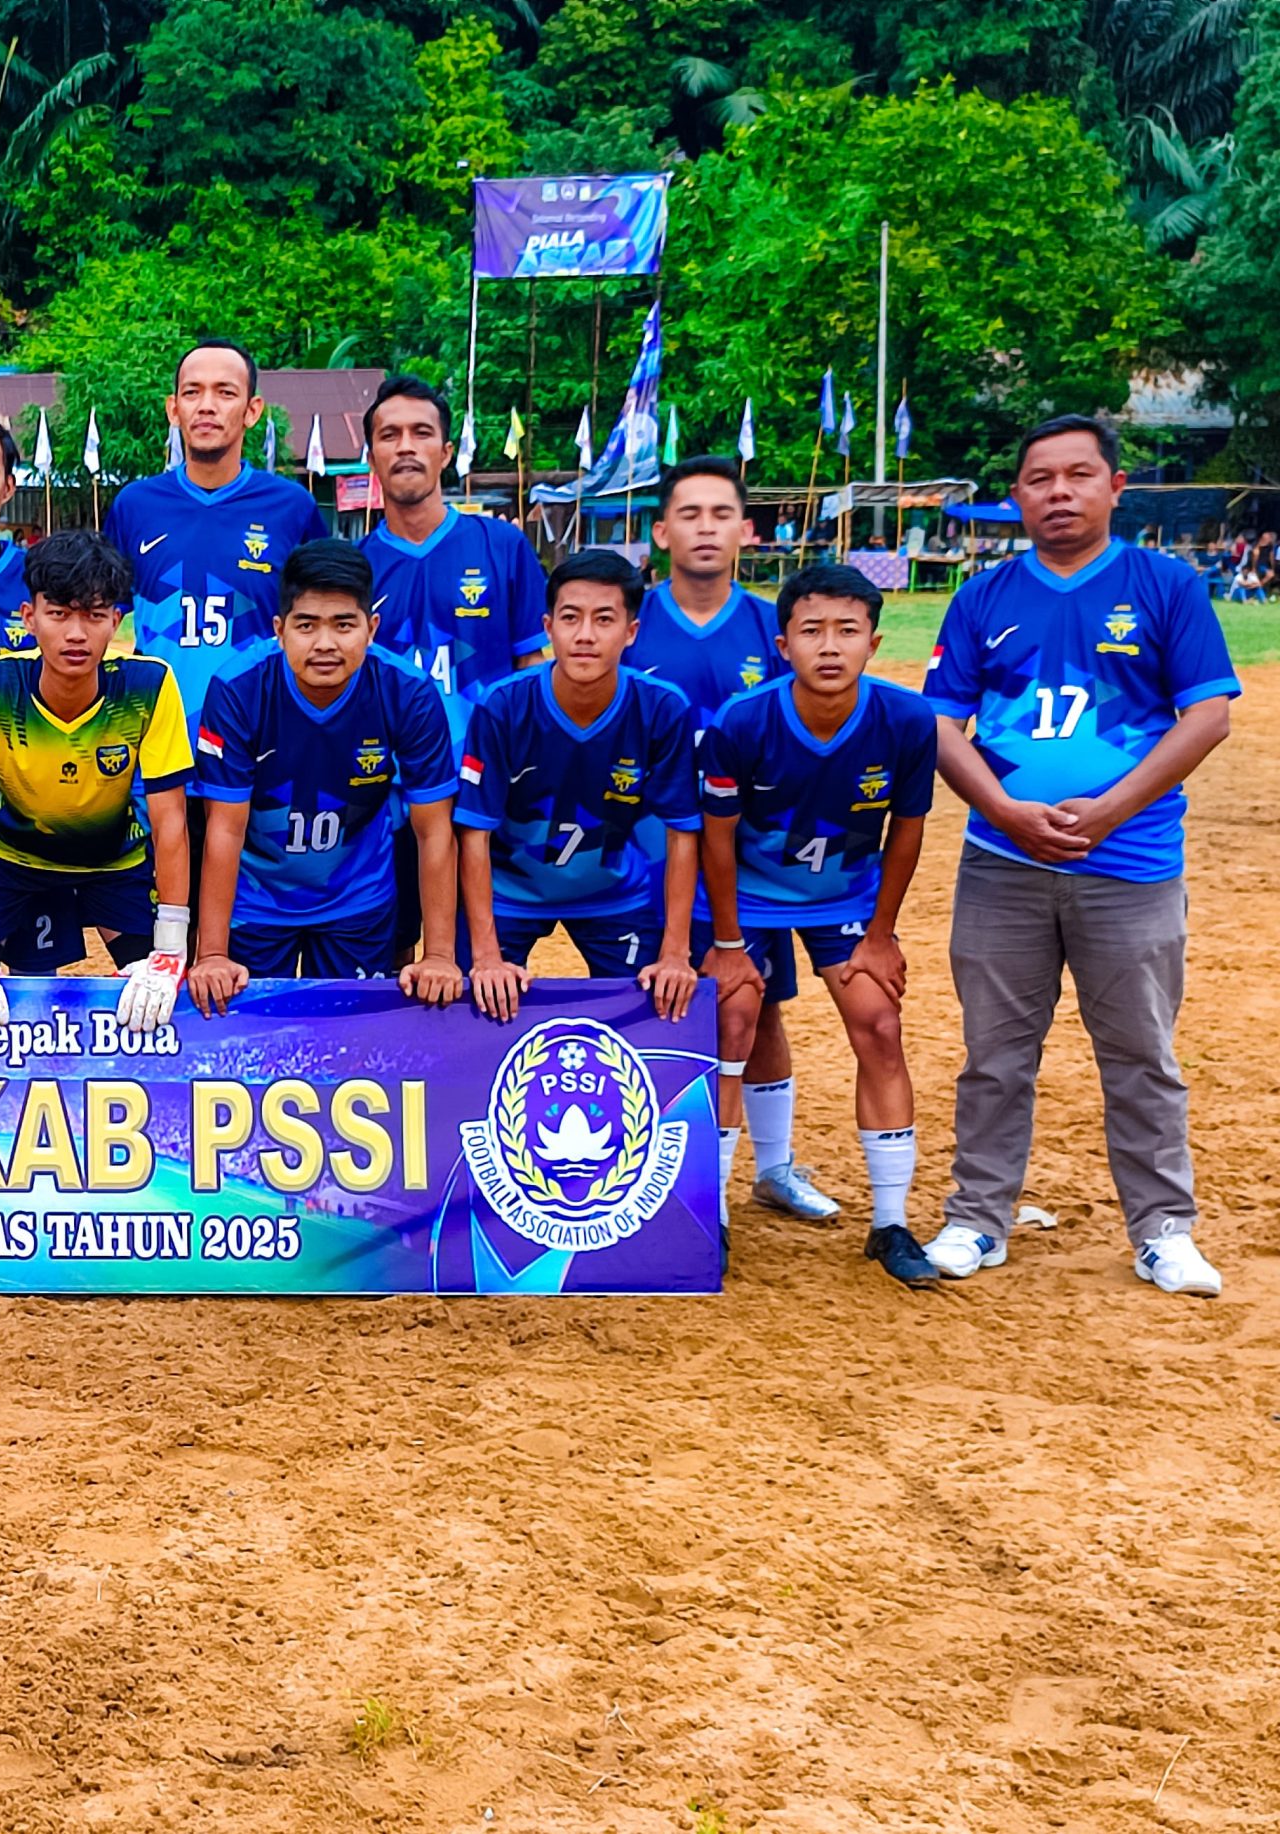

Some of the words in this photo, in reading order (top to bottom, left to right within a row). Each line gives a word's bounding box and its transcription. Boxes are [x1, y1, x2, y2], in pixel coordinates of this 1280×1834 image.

[524, 229, 585, 251] PIALA
[179, 596, 227, 646] 15
[1031, 685, 1090, 740] 17
[285, 811, 340, 853] 10
[554, 823, 585, 866] 7
[795, 837, 828, 873] 4
[35, 915, 54, 950] 2
[541, 1072, 605, 1095] PSSI
[191, 1077, 428, 1193] PSSI
[465, 1125, 509, 1210] FOOTBALL
[507, 1204, 612, 1247] ASSOCIATION
[614, 1206, 636, 1233] OF
[634, 1124, 683, 1215] INDONESIA
[45, 1215, 193, 1257] TAHUN
[202, 1217, 301, 1259] 2025
